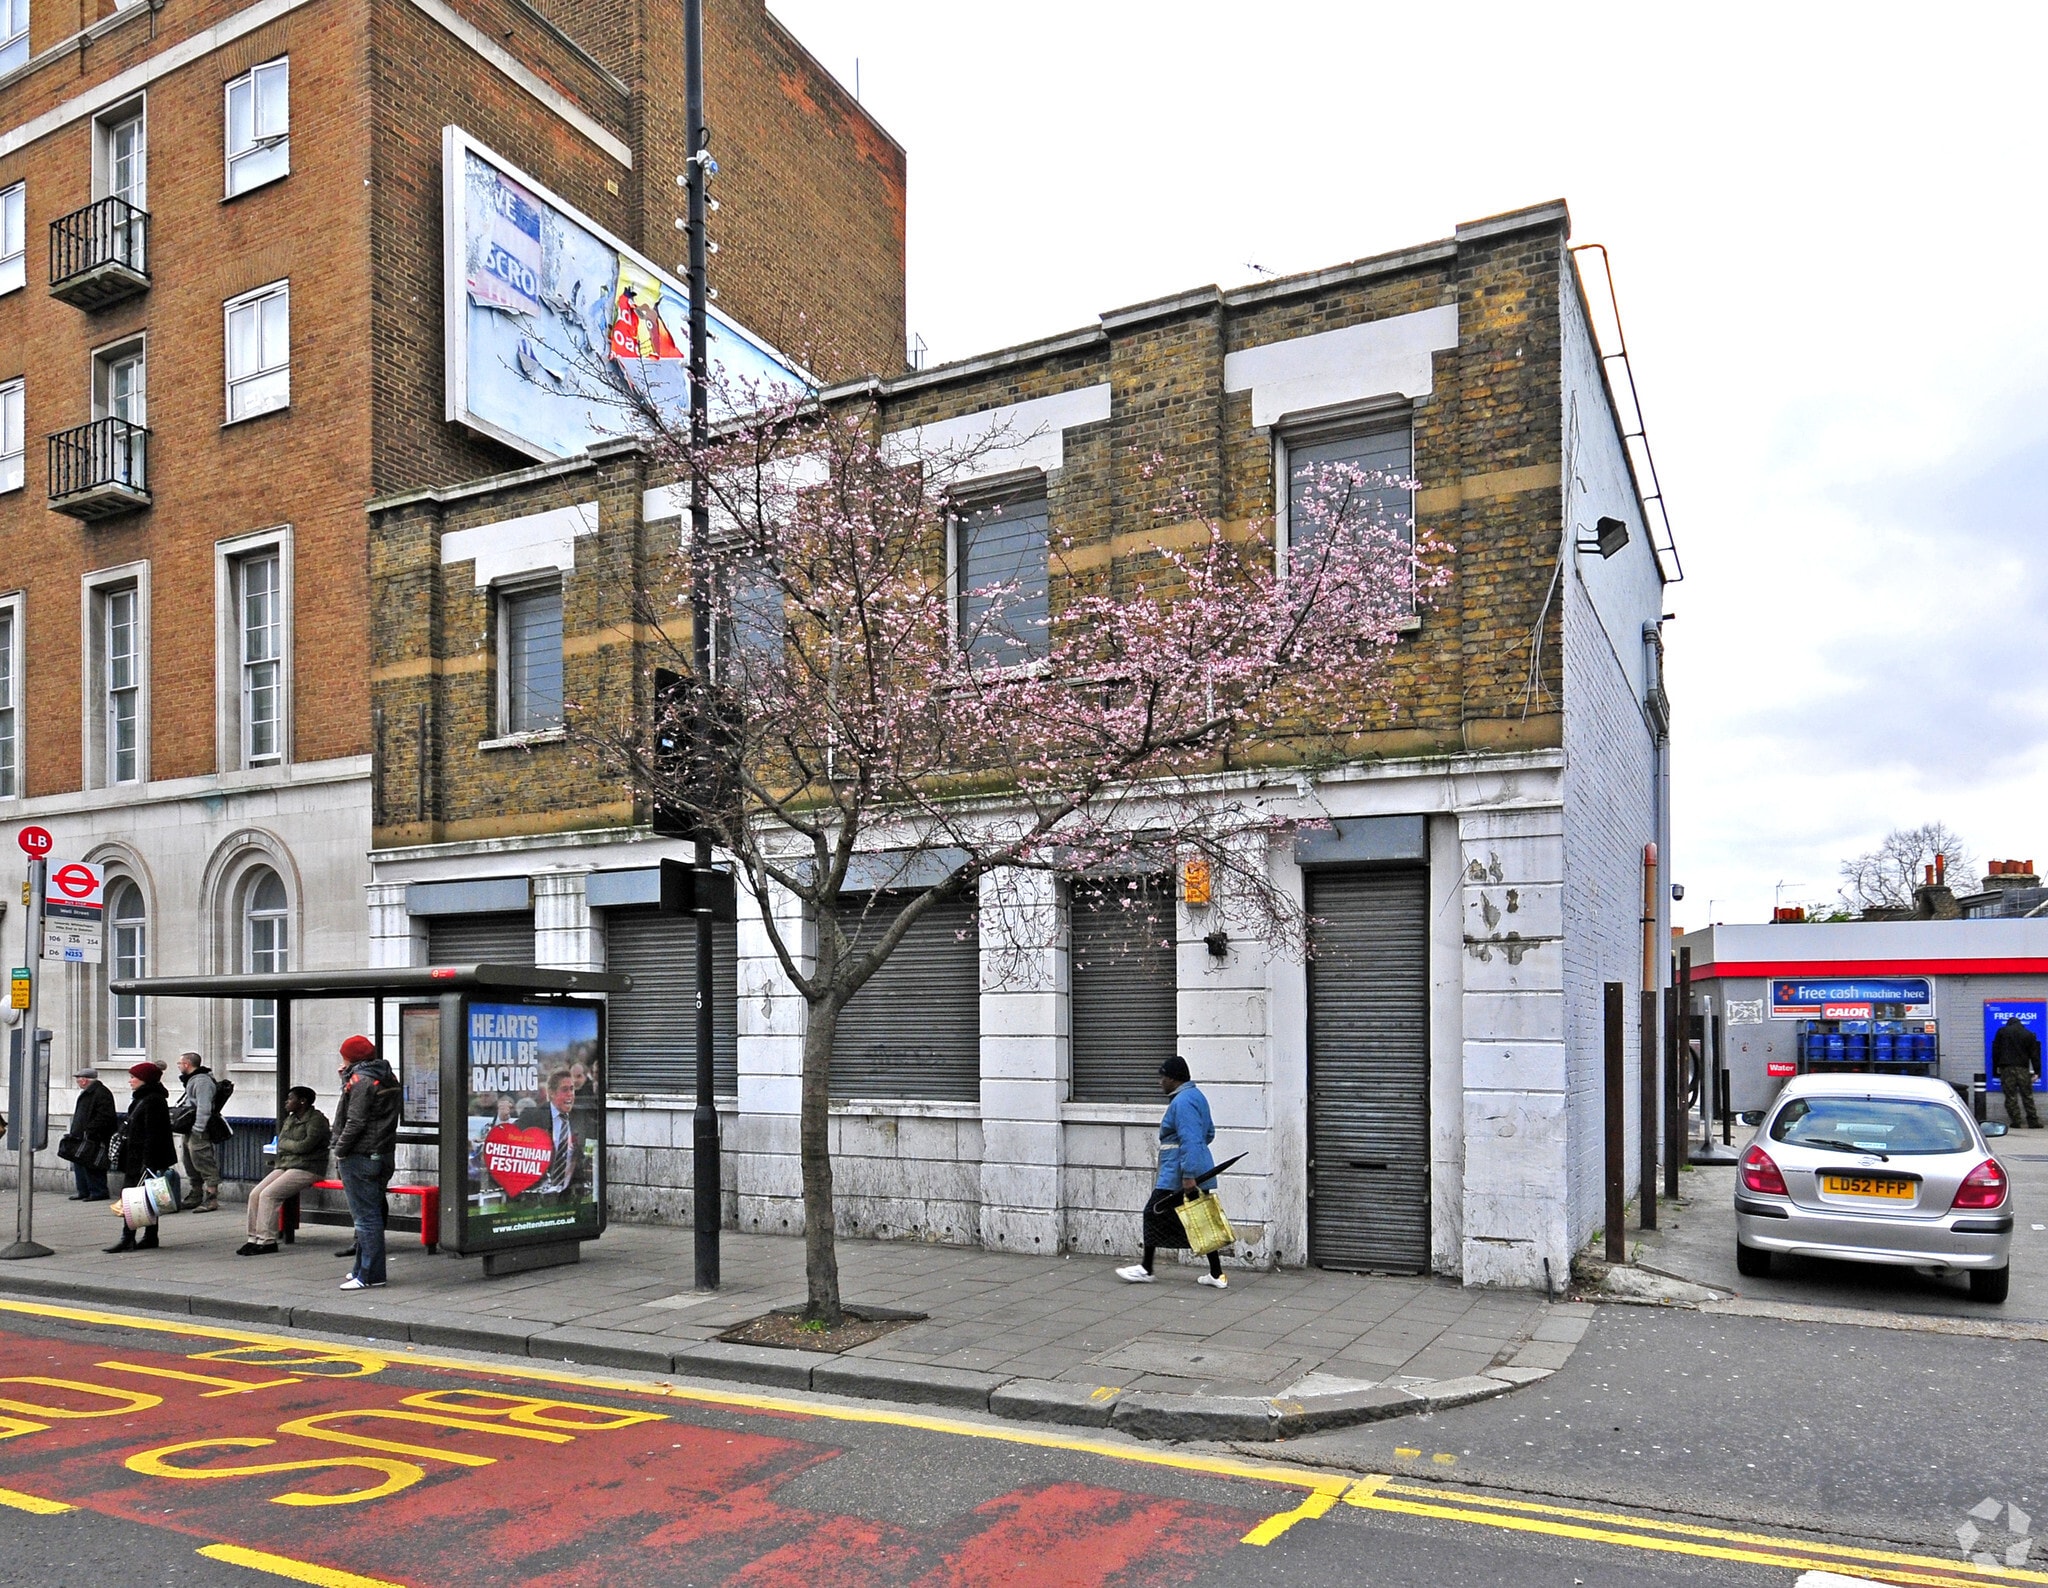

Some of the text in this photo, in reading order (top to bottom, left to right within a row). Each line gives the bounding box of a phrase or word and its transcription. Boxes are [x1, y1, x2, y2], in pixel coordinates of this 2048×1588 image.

[28, 834, 47, 848] LB
[1798, 985, 1925, 999] Free cash machine here
[1825, 1007, 1870, 1019] CALOR
[1994, 1012, 2037, 1020] FREE CASH
[472, 1013, 538, 1039] HEARTS
[472, 1040, 538, 1065] WILL BE
[1769, 1063, 1794, 1072] Water
[472, 1066, 539, 1092] RACING
[485, 1142, 551, 1162] CHELTENHAM
[490, 1156, 543, 1176] FESTIVAL
[1829, 1176, 1908, 1195] LD52 FFP
[492, 1216, 576, 1234] www.cheltenham.co.uk
[124, 1388, 670, 1507] BUS
